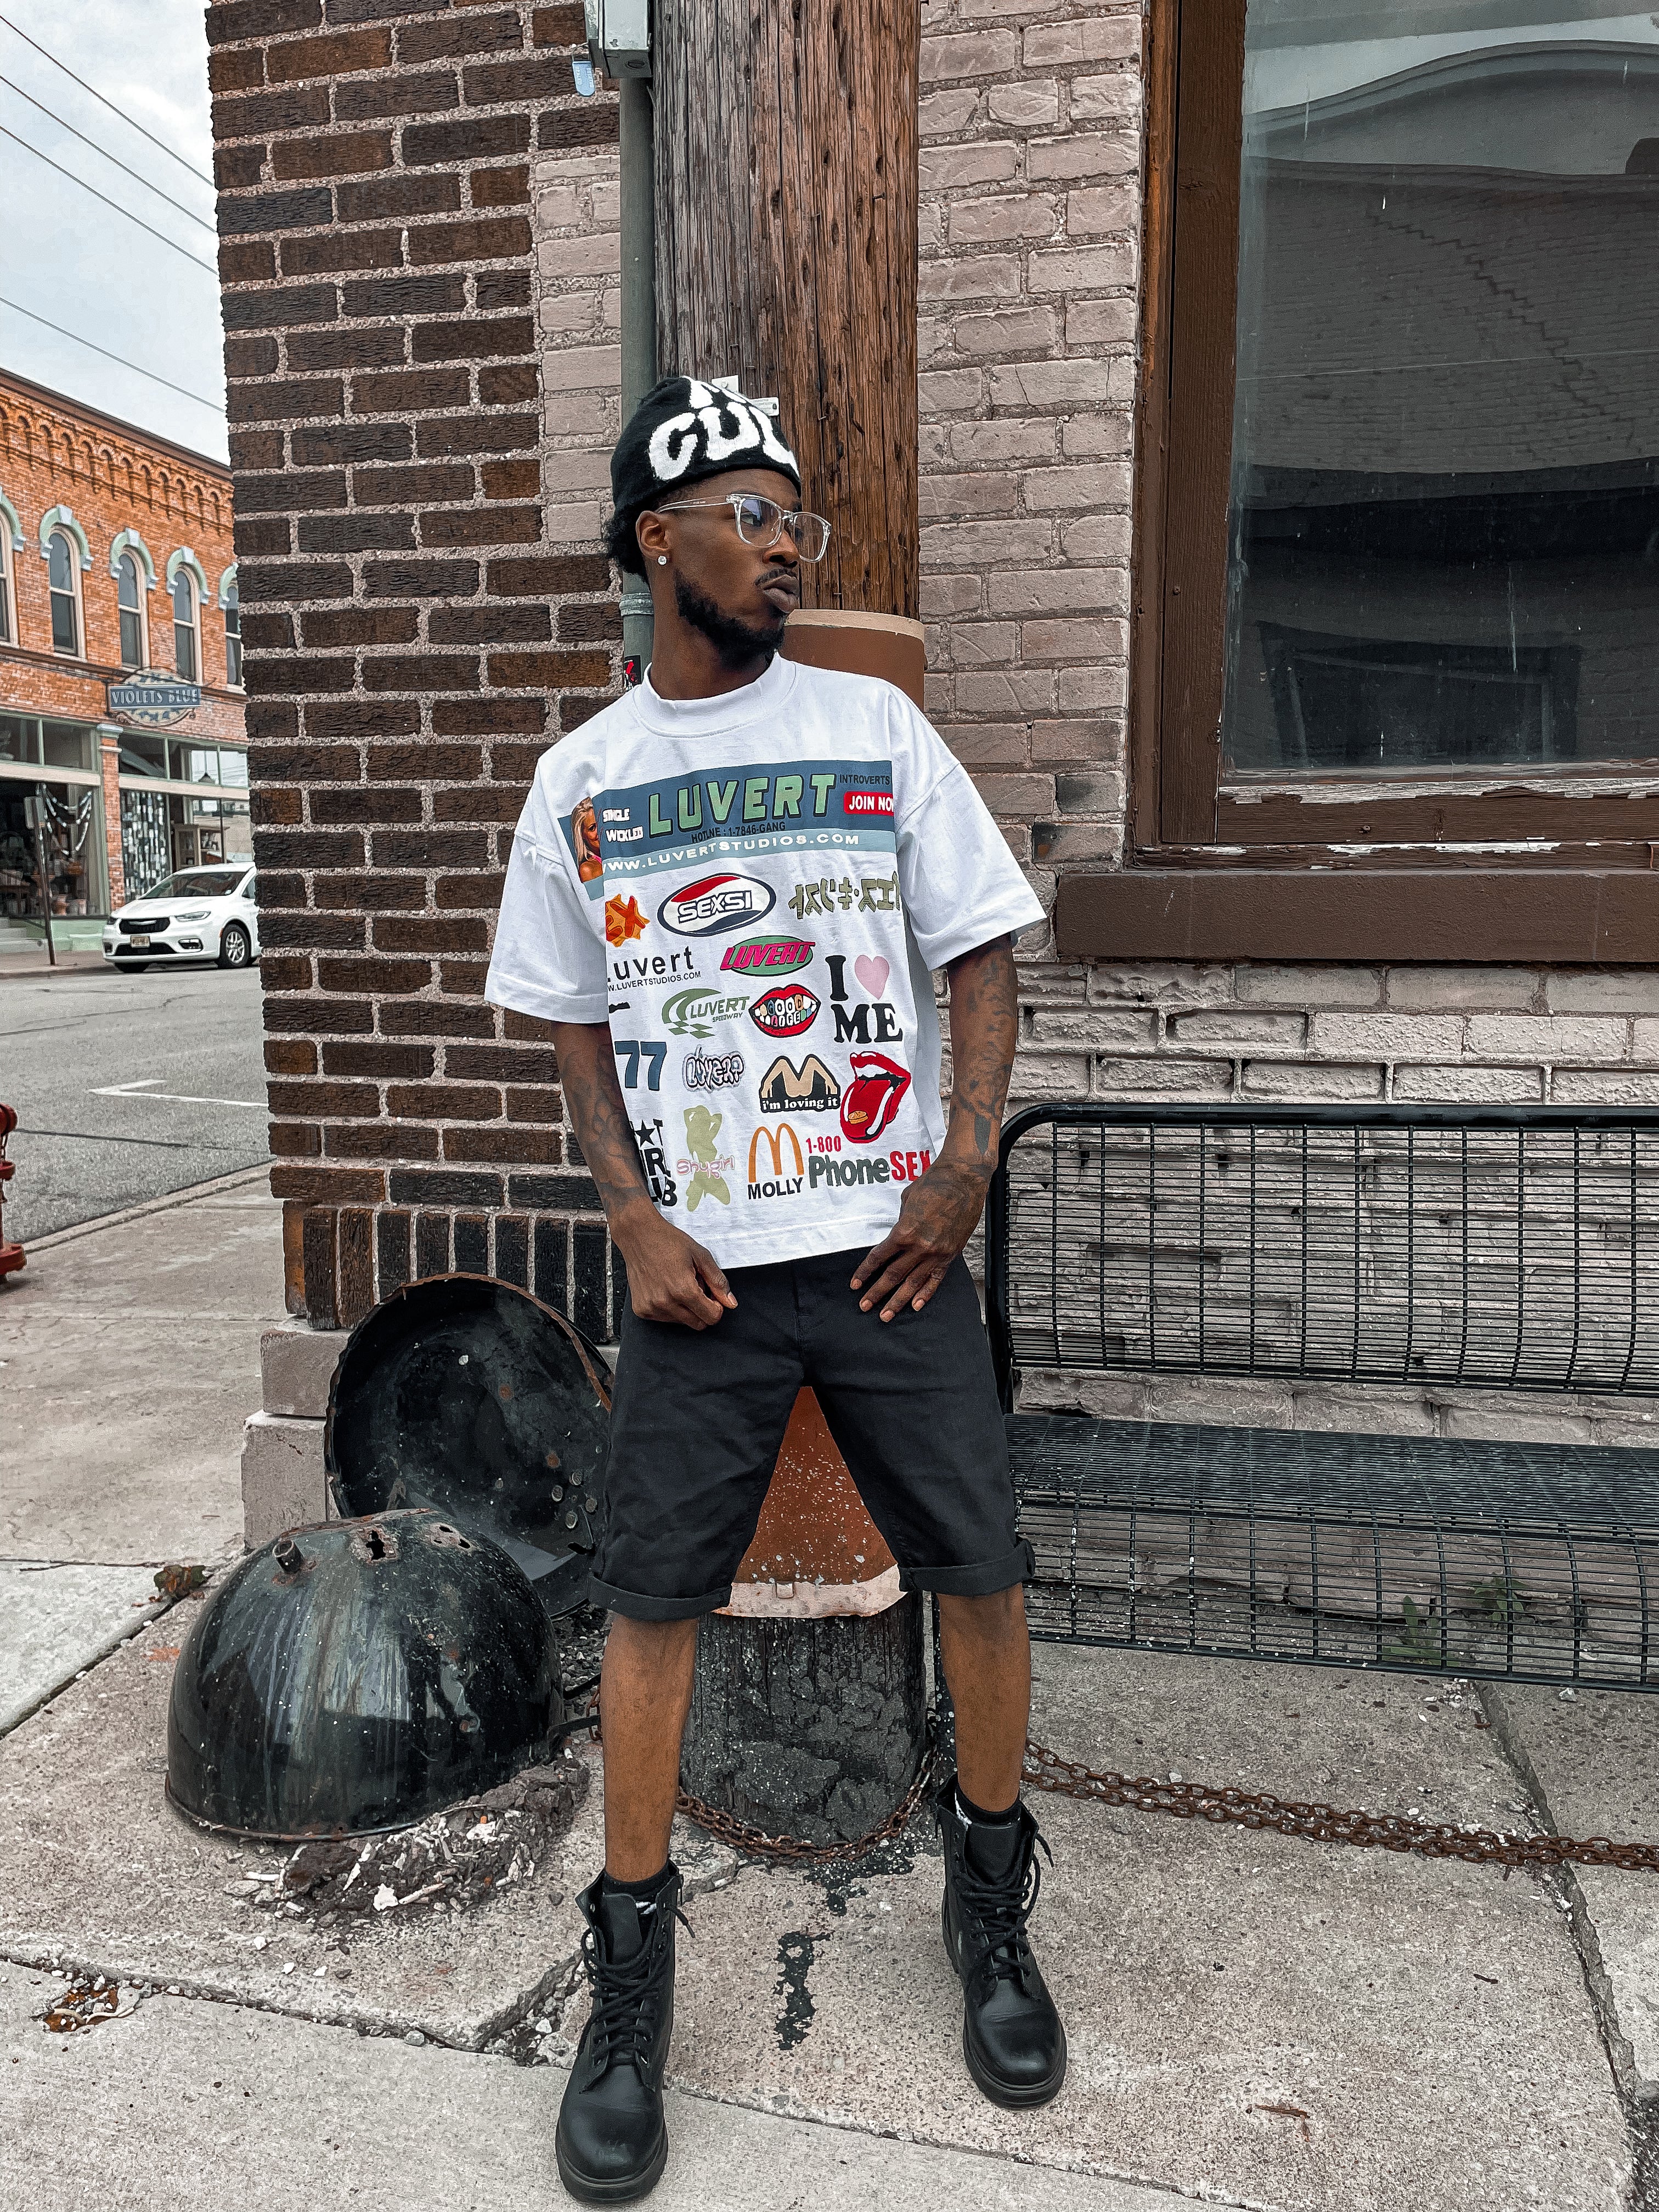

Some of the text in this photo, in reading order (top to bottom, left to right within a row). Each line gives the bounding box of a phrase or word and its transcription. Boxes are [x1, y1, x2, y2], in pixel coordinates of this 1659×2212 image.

[111, 689, 198, 704] VIOLETS BLUE
[839, 774, 890, 786] INTROVERTS
[648, 774, 837, 838] LUVERT
[849, 795, 875, 810] JOIN
[728, 821, 786, 837] 1-7846-GANG
[678, 890, 753, 924] SEXSI
[607, 945, 694, 983] uvert
[720, 941, 816, 971] LUVERT
[825, 955, 849, 1002] I
[691, 996, 751, 1019] LUVERT
[768, 997, 802, 1015] GOOD
[831, 1003, 903, 1044] ME
[762, 1097, 838, 1110] i'm loving it
[805, 1136, 842, 1154] 1-800
[748, 1177, 803, 1200] MOLLY
